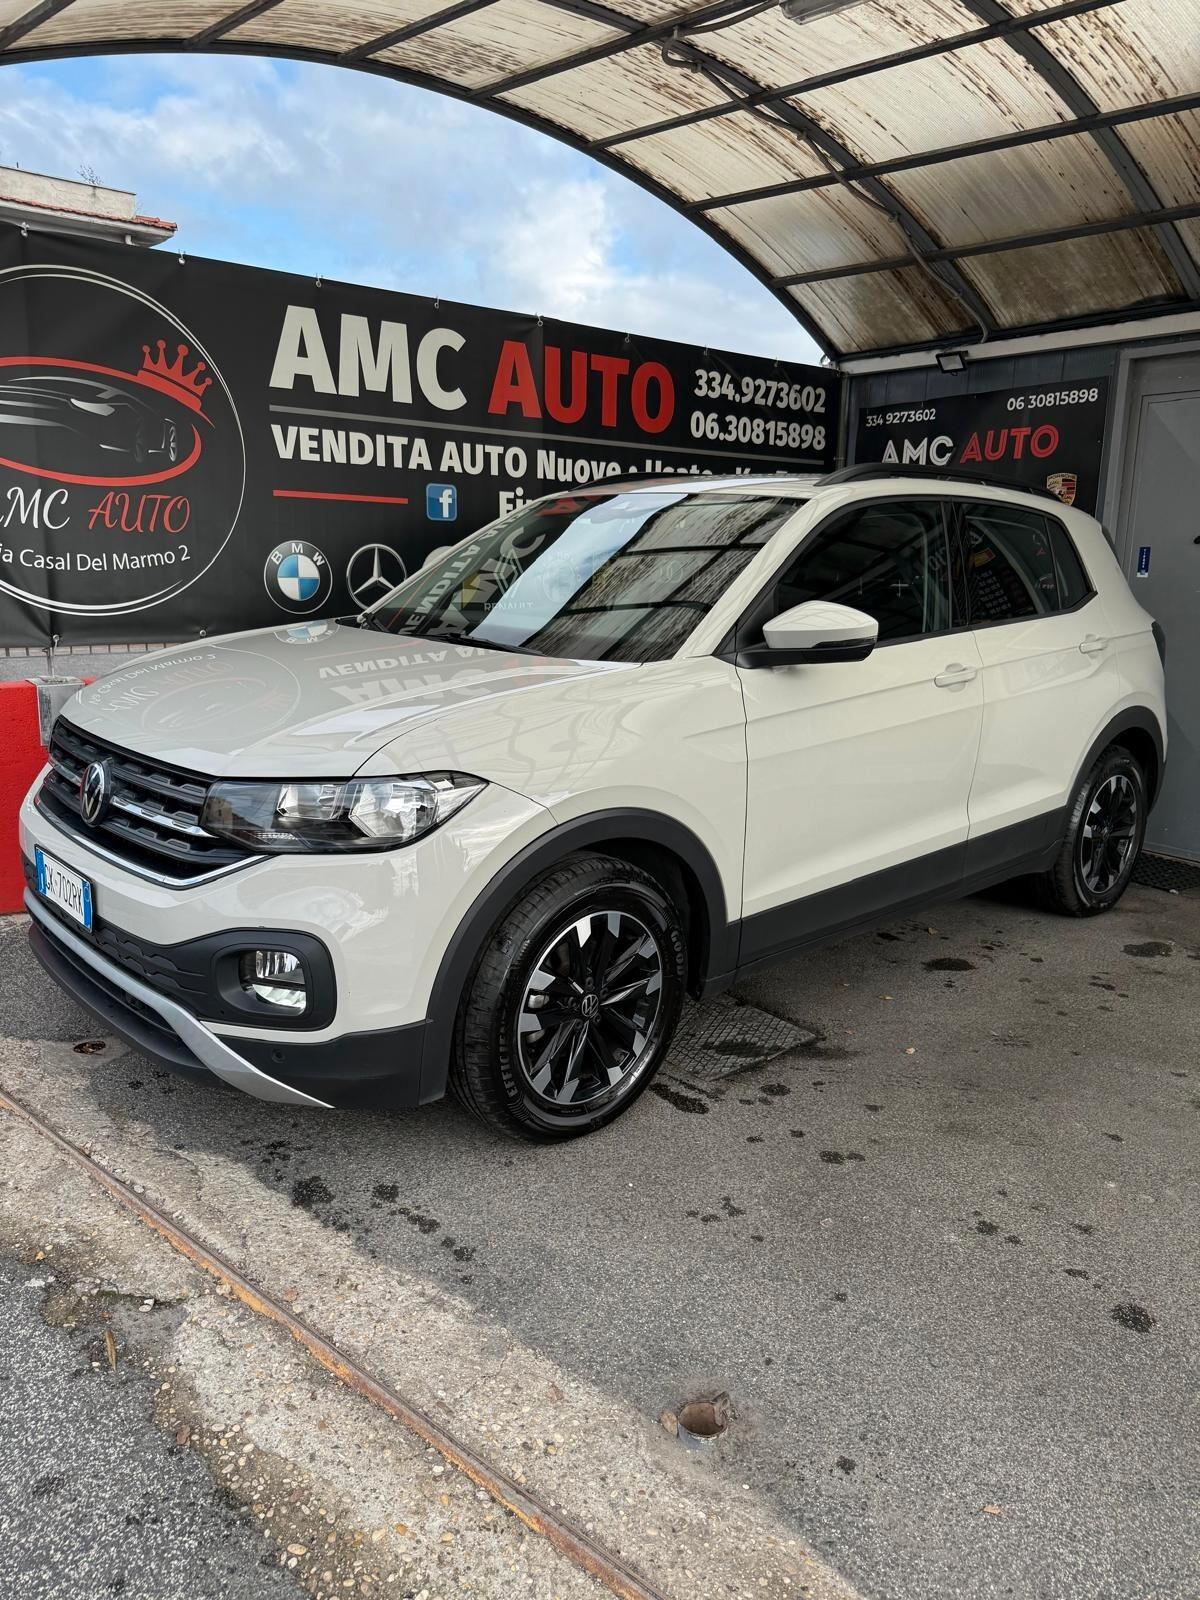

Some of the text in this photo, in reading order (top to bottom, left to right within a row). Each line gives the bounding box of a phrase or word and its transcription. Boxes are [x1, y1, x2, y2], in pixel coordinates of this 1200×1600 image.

[269, 304, 675, 434] AMC AUTO
[694, 368, 826, 413] 334.9273602
[1007, 387, 1099, 411] 06 30815898
[690, 410, 826, 451] 06.30815898
[866, 408, 937, 427] 334 9273602
[270, 423, 622, 484] VENDITA AUTO Nuove
[881, 424, 1059, 466] AMC AUTO
[0, 486, 191, 533] MC AUTO
[19, 549, 71, 571] Casal
[76, 552, 108, 571] Del
[113, 549, 175, 571] Marmo
[177, 545, 191, 561] 2
[271, 542, 324, 567] BMW
